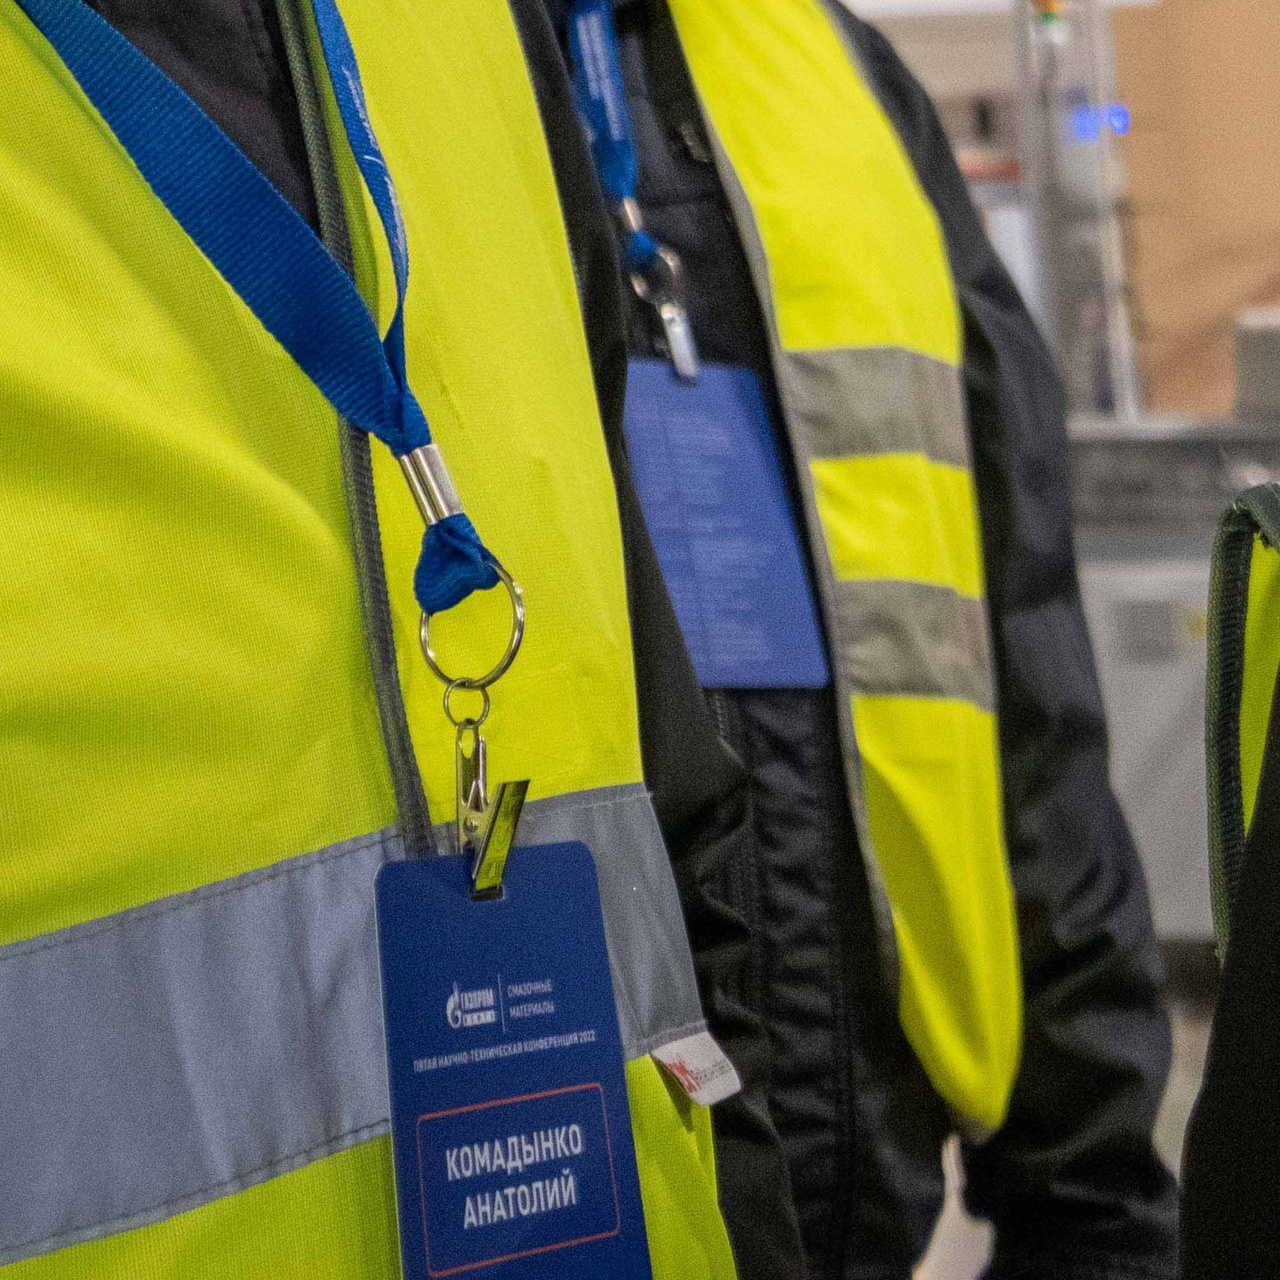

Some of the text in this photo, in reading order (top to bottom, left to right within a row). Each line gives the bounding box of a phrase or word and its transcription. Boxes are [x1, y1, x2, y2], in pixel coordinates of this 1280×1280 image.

[507, 979, 553, 998] СМАЗОЧНЫЕ
[460, 988, 494, 1011] ГАЗПРОМ
[509, 1000, 555, 1018] МАТЕРИАЛЫ
[579, 1029, 596, 1044] 2022
[445, 1123, 583, 1182] КОМАДЫНКО
[463, 1167, 577, 1230] АНАТОЛИЙ
